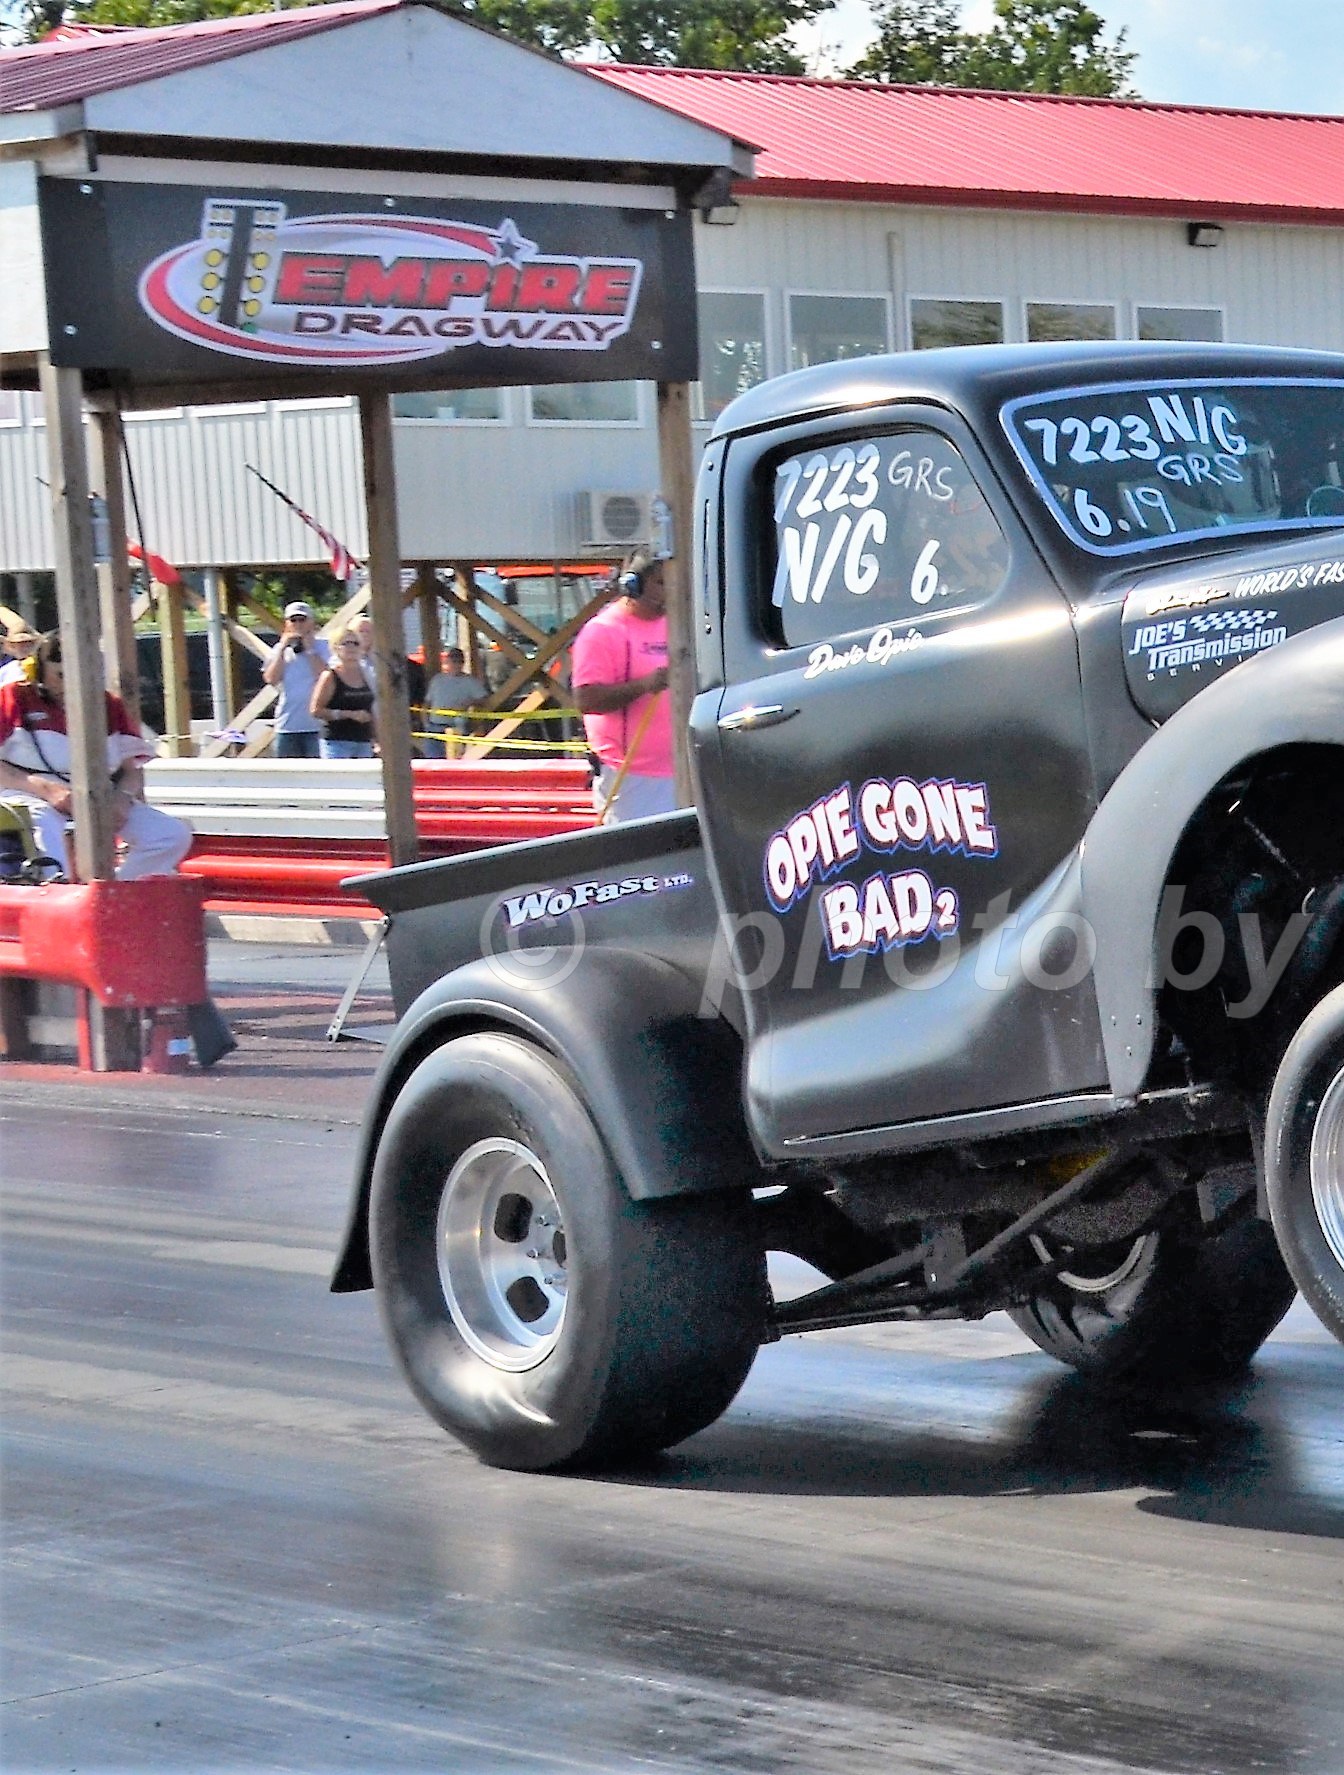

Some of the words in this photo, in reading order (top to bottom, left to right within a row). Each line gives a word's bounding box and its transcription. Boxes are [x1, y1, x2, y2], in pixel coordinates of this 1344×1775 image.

[273, 253, 636, 315] EMPIRE
[293, 311, 625, 343] DRAGWAY
[1024, 414, 1160, 465] 7223
[1147, 394, 1248, 456] N/G
[773, 443, 880, 523] 7223
[887, 451, 954, 500] GRS
[1157, 452, 1244, 487] GRS
[1074, 486, 1177, 537] 6.19
[771, 508, 887, 608] N/G
[1233, 563, 1312, 599] WORLD'S
[1128, 619, 1187, 655] JOE'S
[1146, 626, 1287, 671] Transmission
[765, 783, 859, 912] OPIE
[857, 777, 998, 857] GONE
[503, 876, 660, 928] WoFast
[820, 870, 934, 960] BAD
